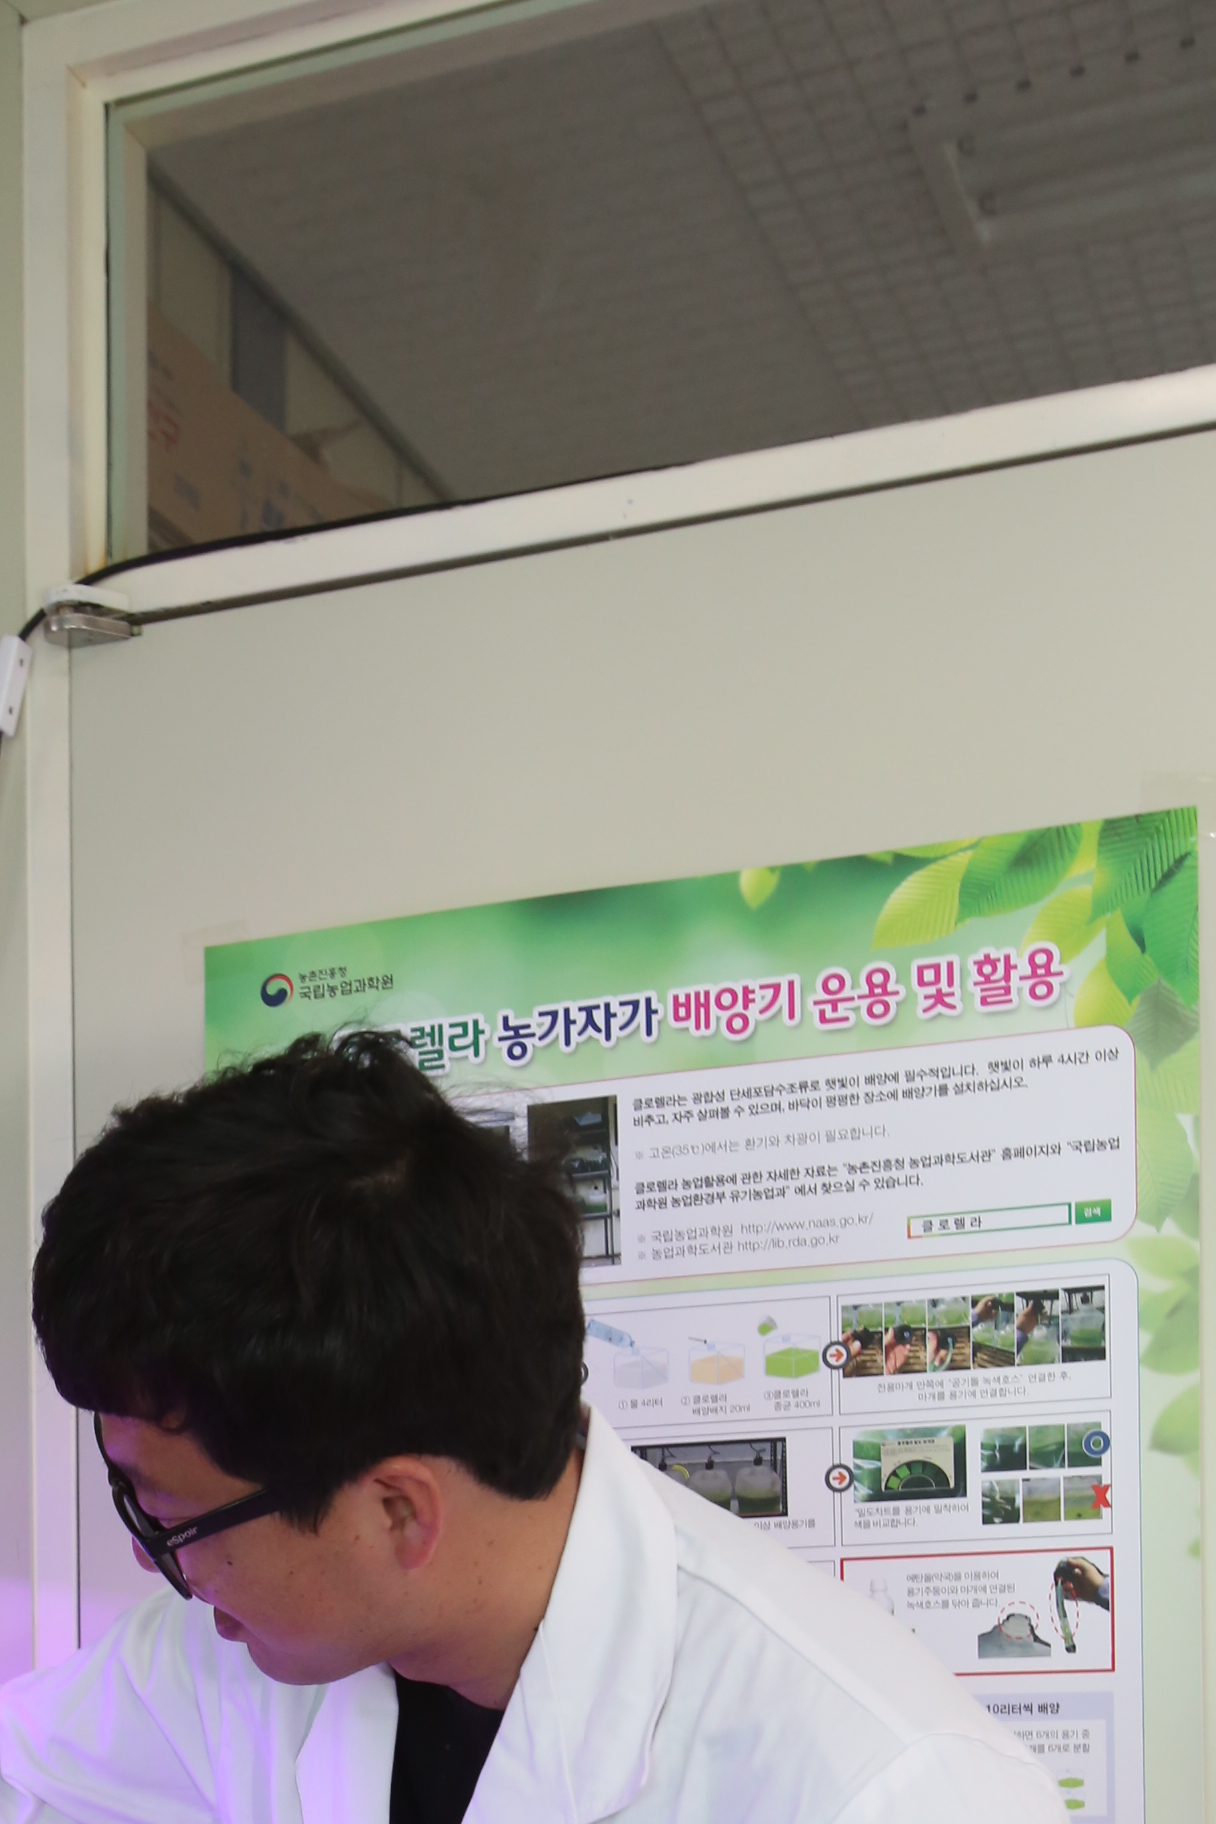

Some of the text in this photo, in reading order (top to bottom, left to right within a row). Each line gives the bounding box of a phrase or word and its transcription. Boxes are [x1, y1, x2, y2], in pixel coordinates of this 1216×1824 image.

[299, 966, 347, 983] 농촌진흥청
[299, 973, 394, 1000] 국립농업과학원
[498, 996, 659, 1062] 농가자가
[673, 978, 795, 1035] 배양기
[813, 967, 900, 1025] 운용
[916, 960, 957, 1014] 및
[973, 947, 1064, 1007] 활용
[632, 1047, 1120, 1112] 클로렐라는 광합성 단세포담수조류로 햇빛이 배양에 필수적입니다. 햇빛이 하루 4시간 이상
[671, 1110, 695, 1125] 자주
[697, 1107, 732, 1122] 살펴볼
[733, 1106, 746, 1118] 수
[788, 1096, 823, 1112] 바닥이
[825, 1092, 860, 1109] 평평한
[864, 1088, 899, 1105] 장소에
[901, 1084, 950, 1101] 배양기를
[953, 1076, 1028, 1096] 설치하십시오.
[744, 1133, 781, 1149] 환기와
[784, 1129, 821, 1146] 차광이
[825, 1123, 890, 1143] 필요합니다.
[634, 1178, 679, 1195] 클로렐라
[681, 1173, 738, 1191] 농업활용에
[740, 1170, 763, 1186] 관한
[766, 1167, 801, 1182] 자세한
[803, 1163, 839, 1179] 자료는
[1001, 1142, 1062, 1162] 홈페이지와
[634, 1196, 668, 1212] 과학원
[671, 1192, 727, 1208] 농업환경부
[794, 1182, 818, 1197] 에서
[820, 1180, 856, 1195] 찾으실
[858, 1178, 871, 1190] 수
[873, 1173, 924, 1191] 있습니다.
[651, 1213, 874, 1244] 국립농업과학원 http://www.naas.go.kr/
[651, 1233, 840, 1261] 농업과학도서관 http://lib.rda.go.kr
[1037, 1701, 1061, 1716] 배양
